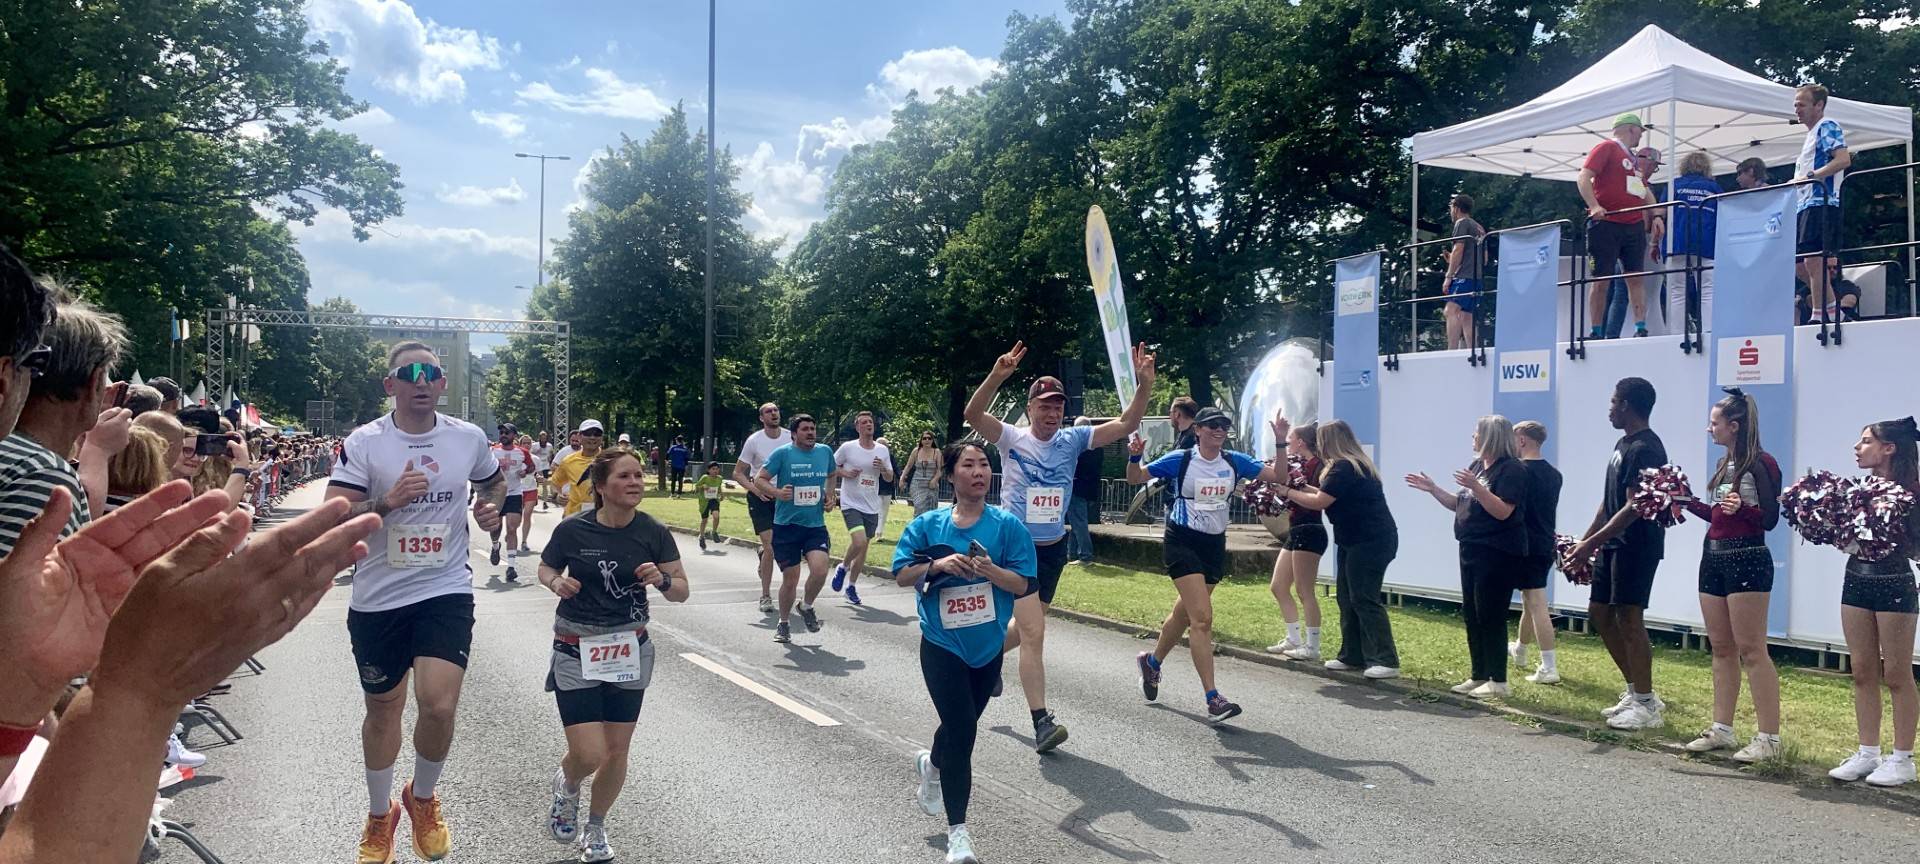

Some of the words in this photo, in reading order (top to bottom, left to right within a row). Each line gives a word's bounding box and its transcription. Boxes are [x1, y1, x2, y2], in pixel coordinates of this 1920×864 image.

[799, 490, 817, 499] 1134
[1200, 486, 1227, 497] 4715
[1032, 495, 1060, 507] 4716
[398, 536, 444, 554] 1336
[946, 594, 987, 615] 2535
[589, 643, 631, 663] 2774
[616, 673, 634, 681] 2774
